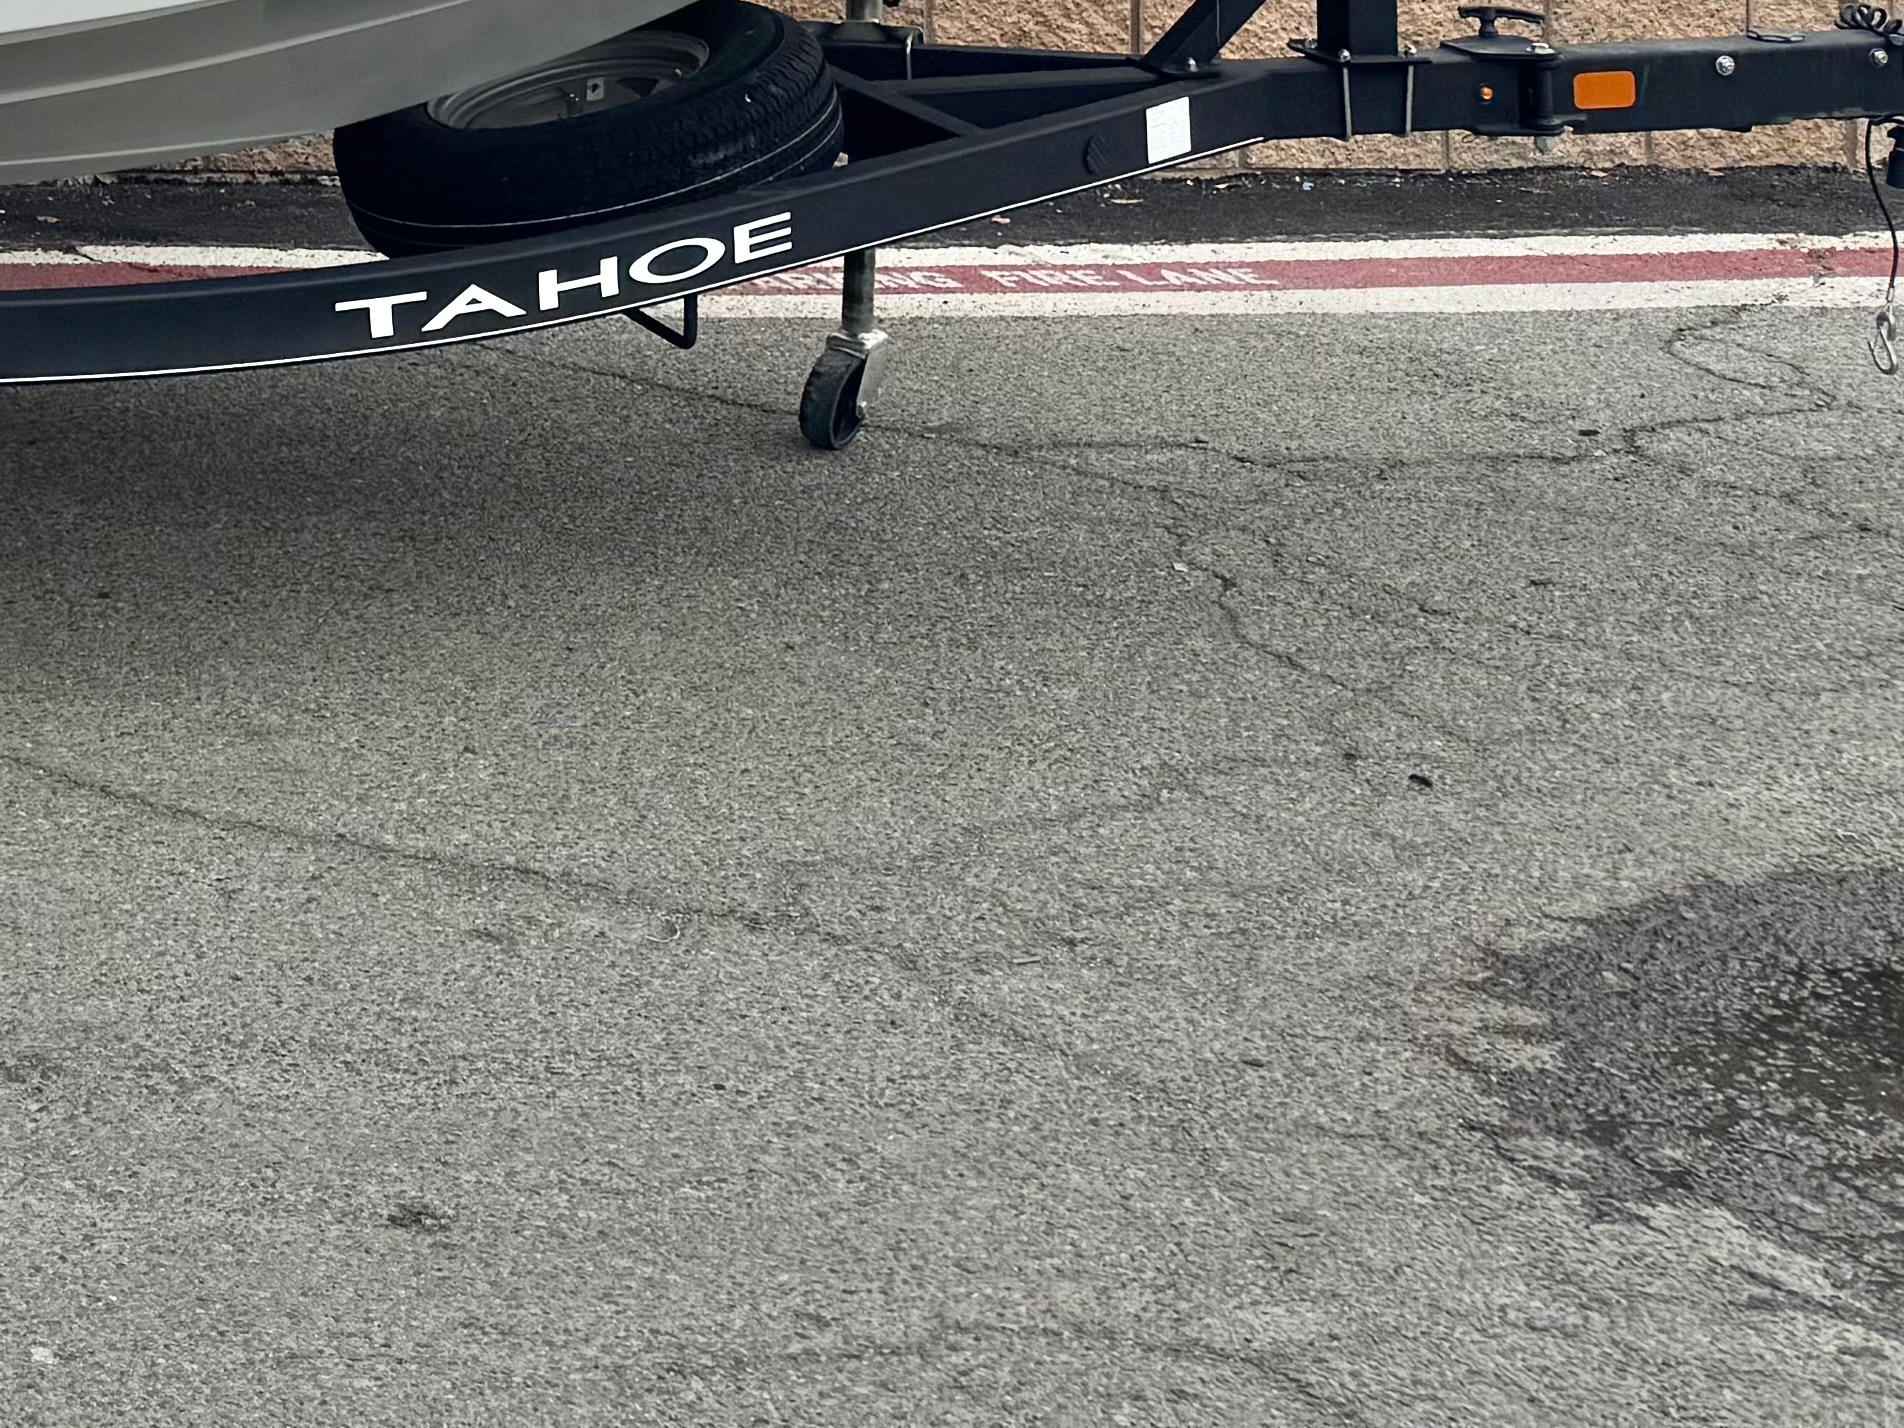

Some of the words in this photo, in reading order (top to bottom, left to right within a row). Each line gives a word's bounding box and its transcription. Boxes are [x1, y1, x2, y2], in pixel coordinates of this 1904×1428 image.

[335, 211, 792, 339] TAHOE
[980, 269, 1121, 287] FIRE
[1115, 267, 1280, 286] LANE
